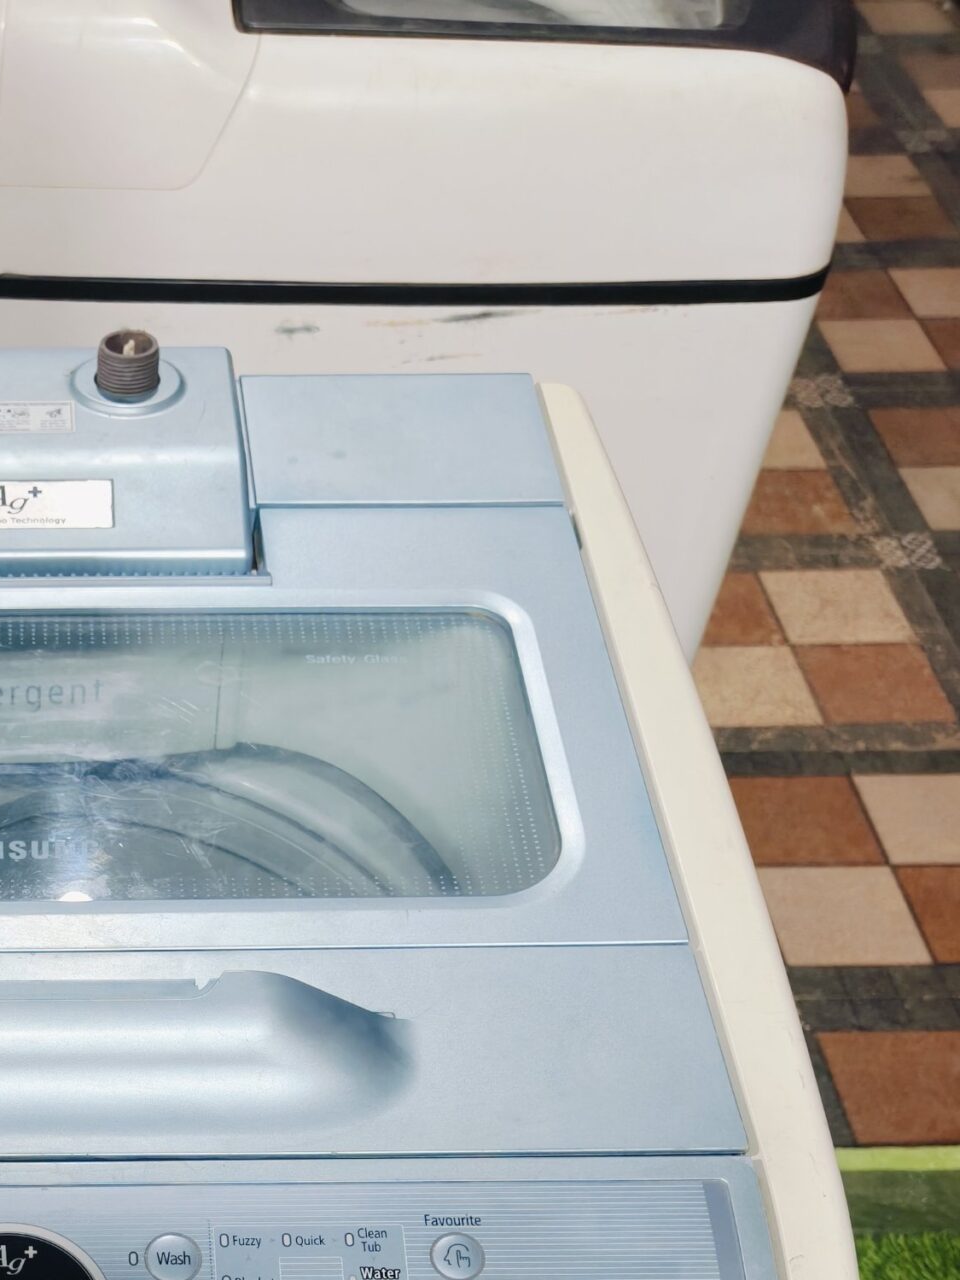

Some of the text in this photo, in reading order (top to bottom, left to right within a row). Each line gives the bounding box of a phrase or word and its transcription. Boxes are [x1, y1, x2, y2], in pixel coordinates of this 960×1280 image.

[11, 517, 67, 526] Technology
[305, 654, 356, 665] Safety
[424, 1214, 482, 1227] Favourite
[357, 1228, 388, 1239] Clean
[232, 1236, 262, 1249] Fuzzy
[295, 1235, 326, 1248] Quick
[361, 1241, 382, 1253] Tub
[156, 1252, 191, 1266] Wash
[360, 1266, 400, 1280] Water
